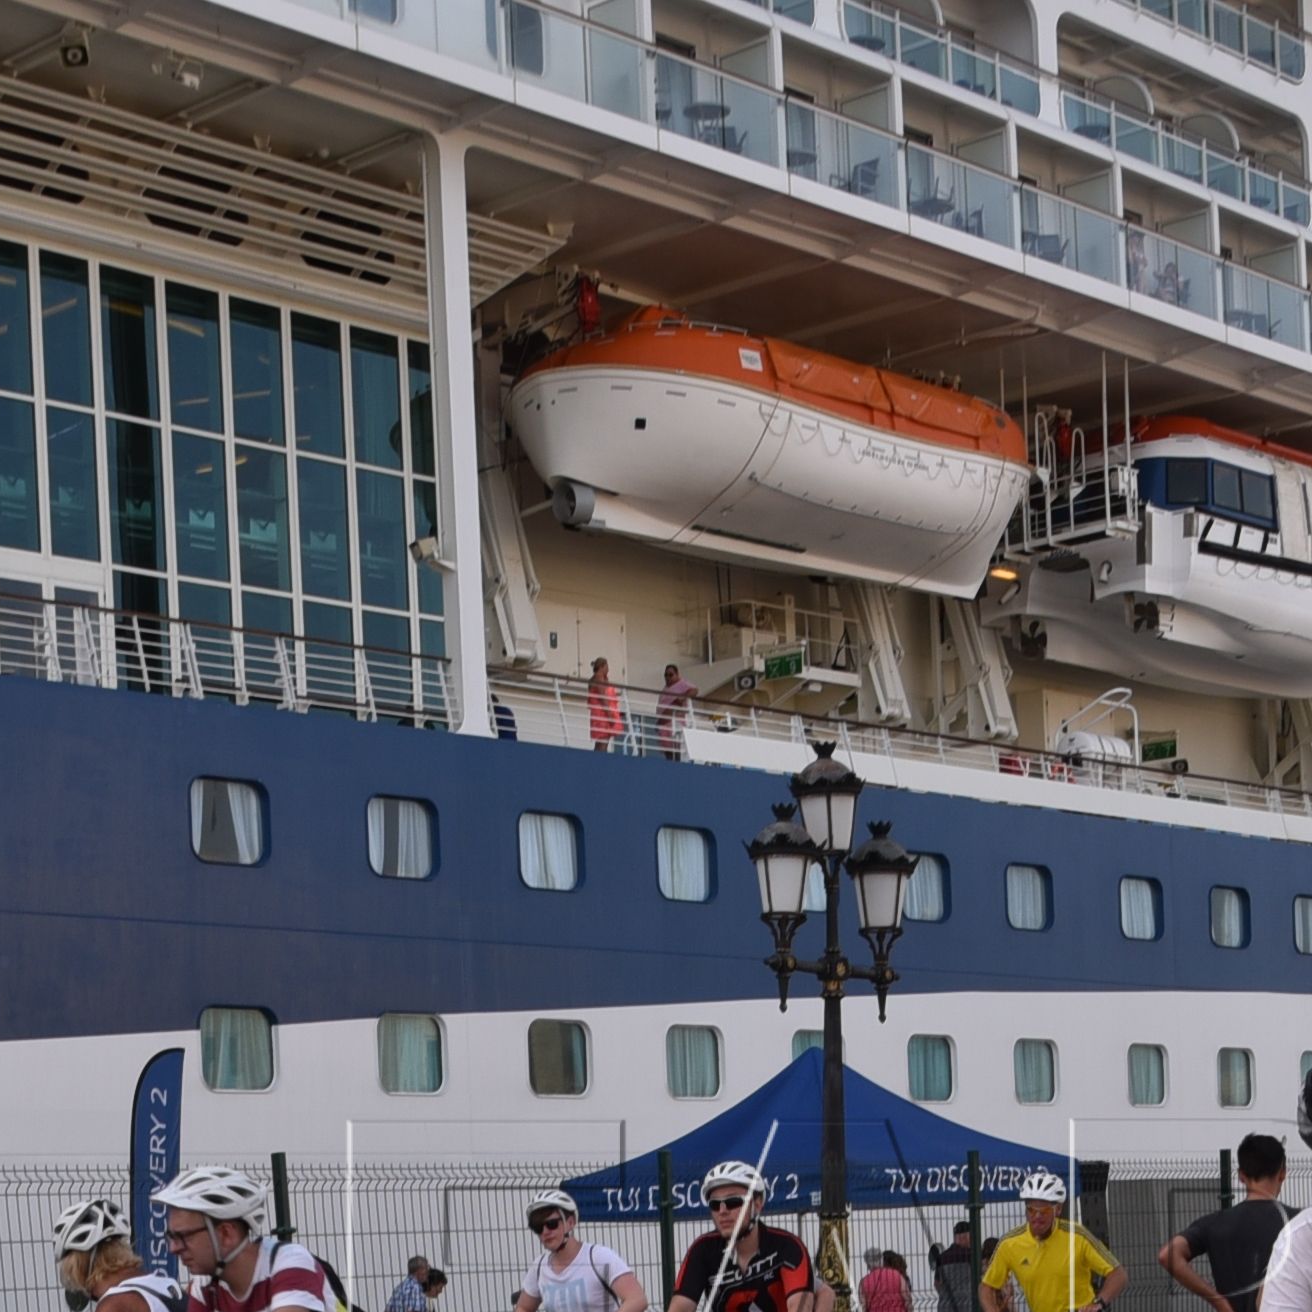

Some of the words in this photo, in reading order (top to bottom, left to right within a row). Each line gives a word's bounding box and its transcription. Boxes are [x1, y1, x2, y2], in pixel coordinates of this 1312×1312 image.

[150, 1087, 167, 1106] 2
[785, 1172, 800, 1200] 2
[884, 1168, 920, 1194] TUI
[602, 1186, 640, 1212] TUI
